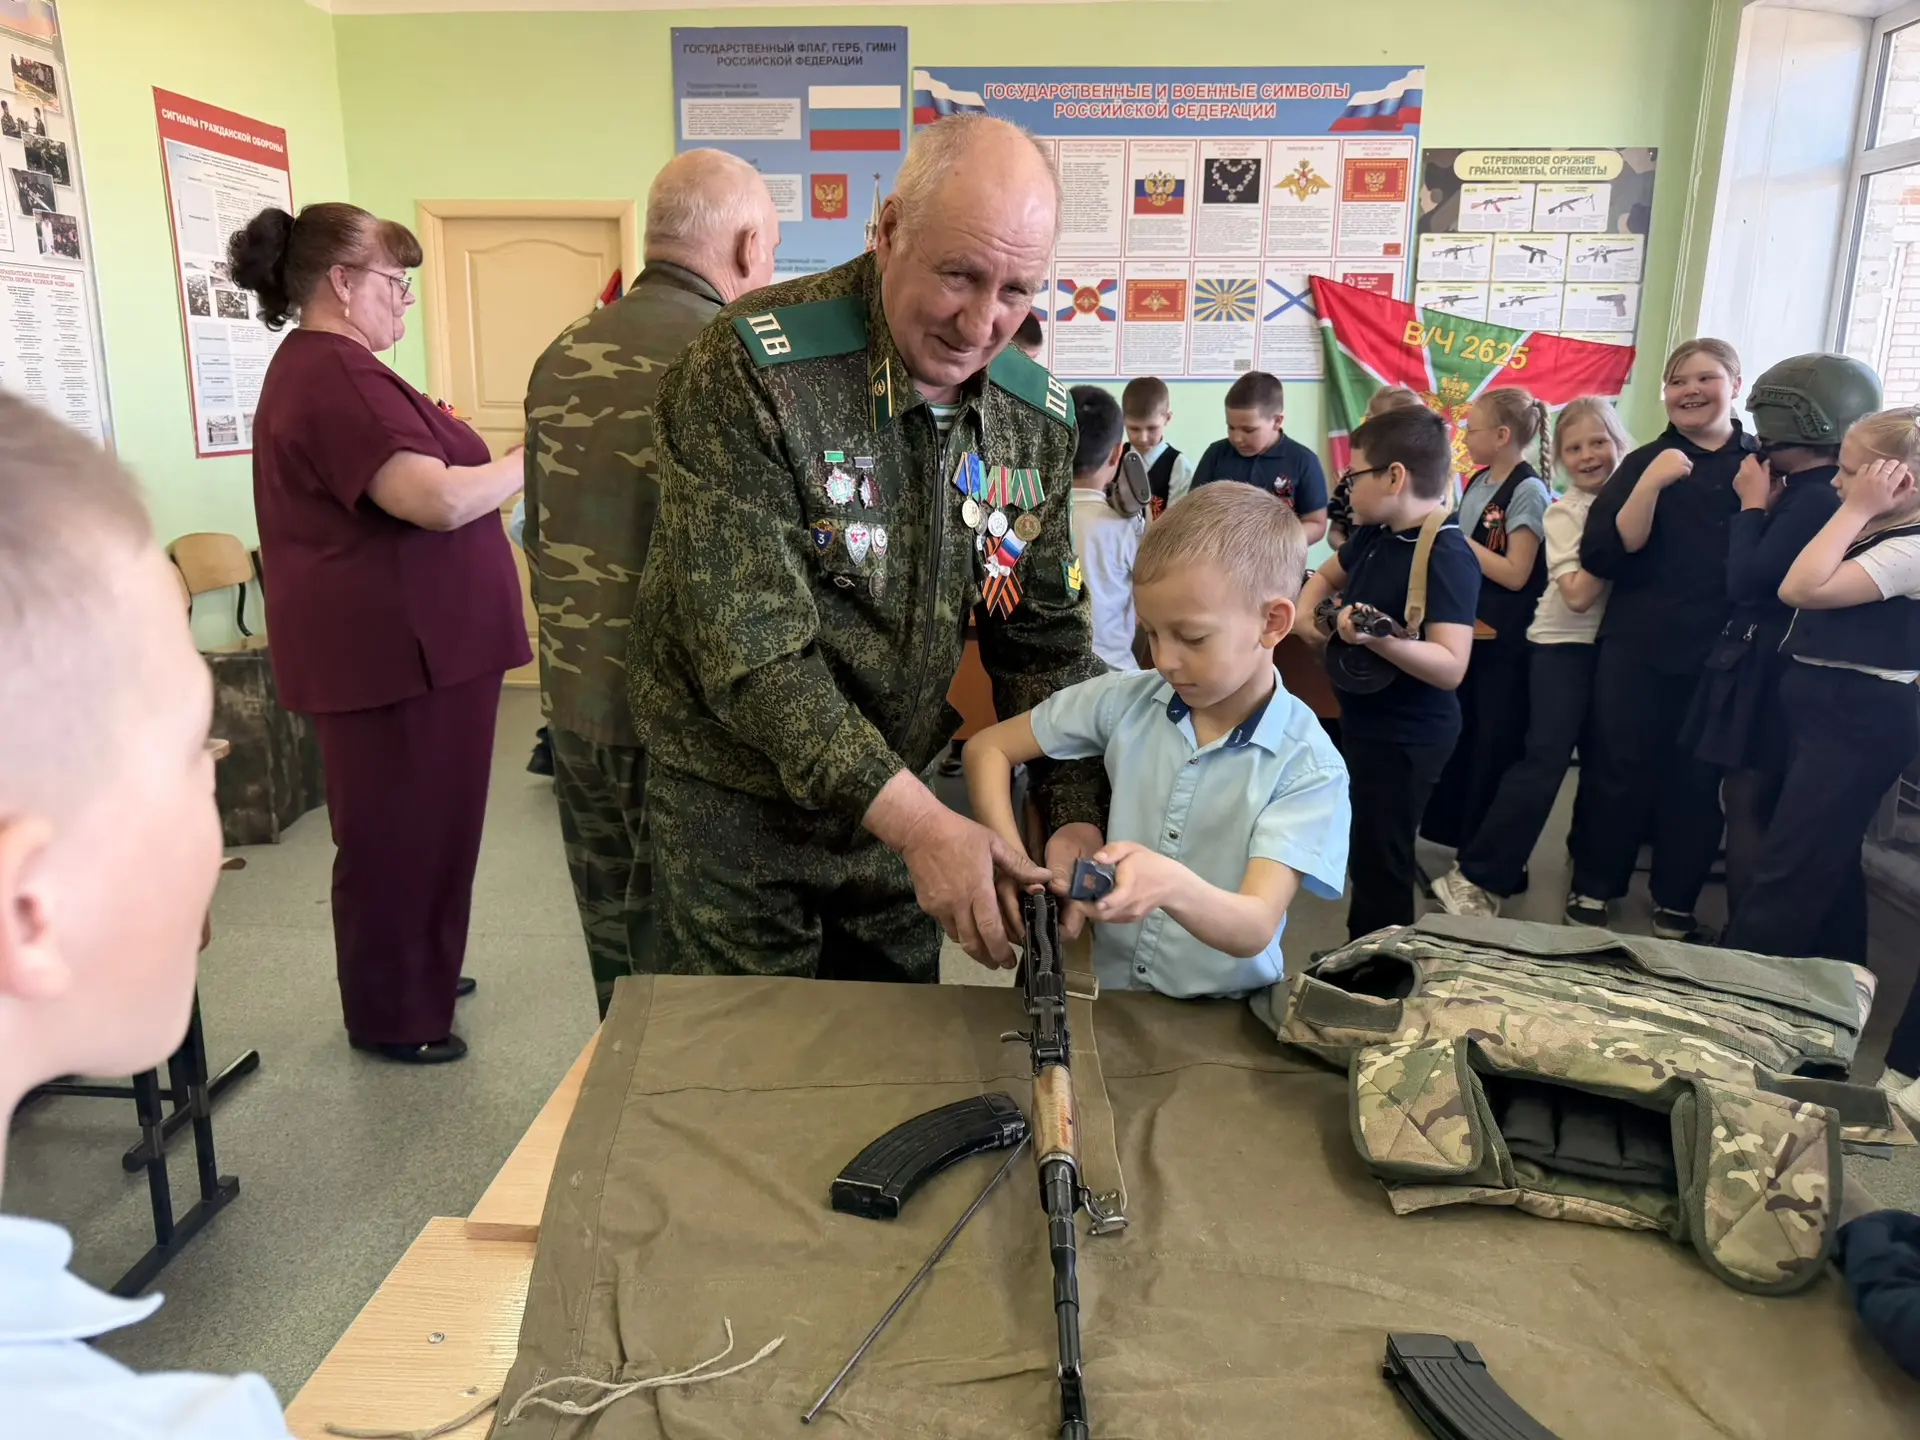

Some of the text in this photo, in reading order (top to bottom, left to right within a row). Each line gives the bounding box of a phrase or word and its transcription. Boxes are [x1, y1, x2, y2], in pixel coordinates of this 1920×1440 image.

[683, 42, 896, 54] ГОСУДАРСТВЕННЫЙ ФЛАГ, ГЕРБ, ГИМН
[717, 54, 863, 67] РОССИЙСКОЙ ФЕДЕРАЦИИ
[985, 83, 1350, 101] ГОСУДАРСТВЕННЫЕ И ВОЕННЫЕ СИМВОЛЫ
[1054, 100, 1276, 120] РОССИЙСКОЙ ФЕДЕРАЦИИ
[161, 108, 284, 153] СИГНАЛЫ ГРАЖДАНСКОЙ ОБОРОНЫ
[1482, 156, 1596, 165] СТРЕЛКОВОЕ ОРУЖИЕ
[1469, 166, 1607, 176] ГРАНАТОМЕТЫ, ОГНЕМЕТЫ
[746, 312, 792, 356] ПВ
[1403, 320, 1530, 370] В/Ч 2625
